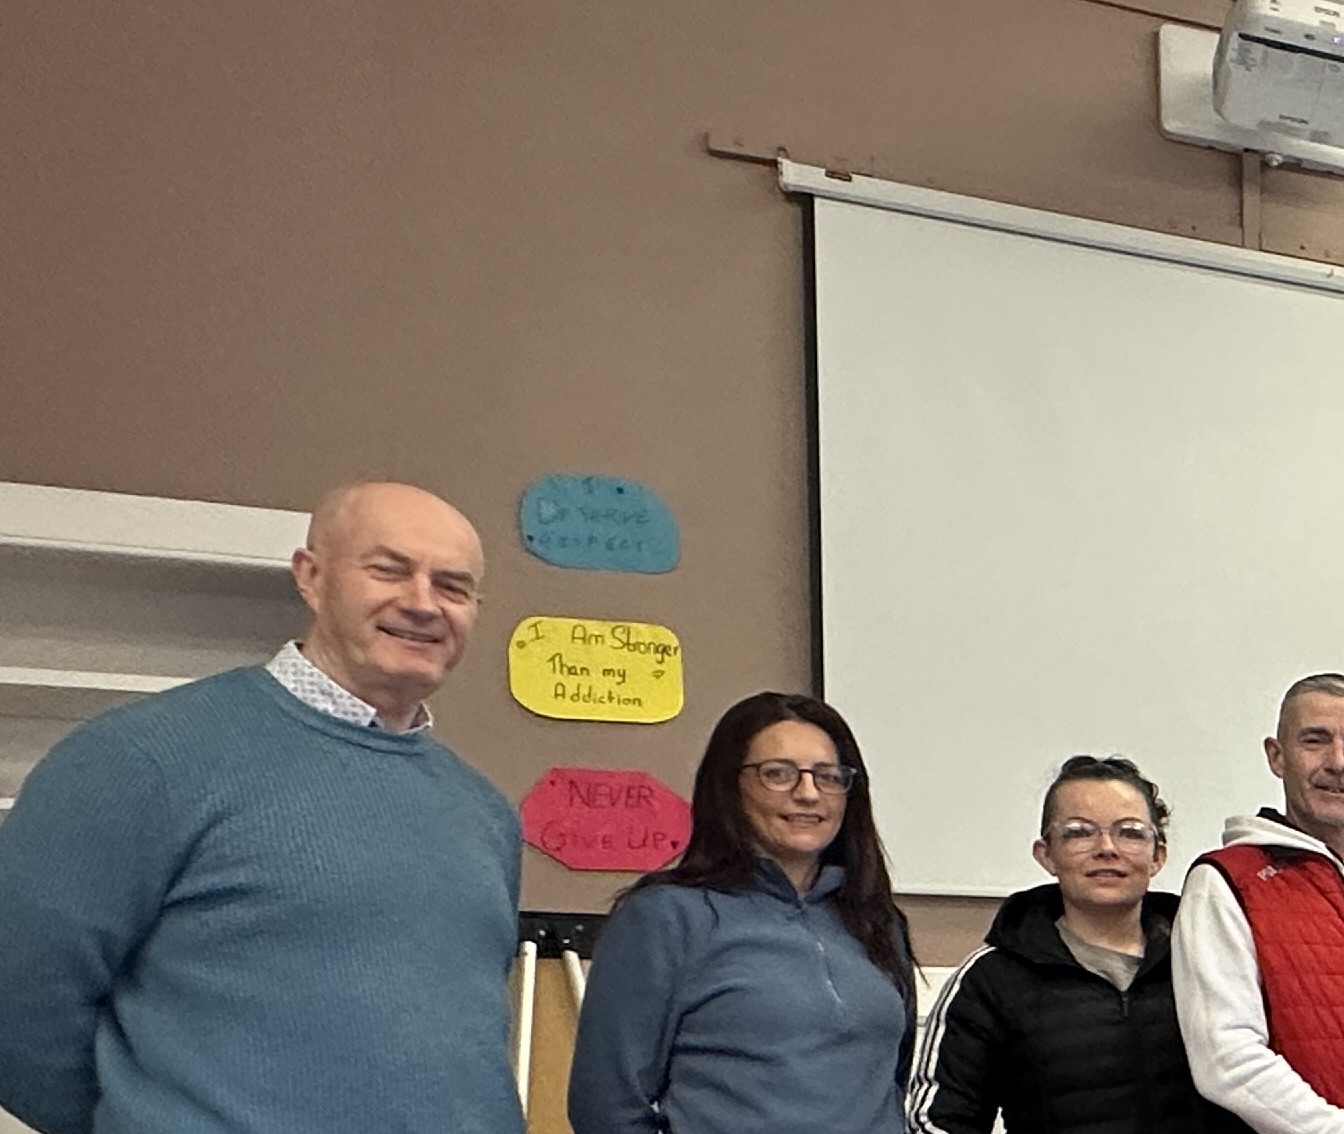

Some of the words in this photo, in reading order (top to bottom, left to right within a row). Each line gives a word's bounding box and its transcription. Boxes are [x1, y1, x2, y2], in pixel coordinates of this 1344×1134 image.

[528, 621, 546, 641] I
[571, 624, 606, 645] Am
[610, 625, 680, 664] Stronger
[547, 653, 590, 677] Than
[602, 667, 627, 686] my
[554, 682, 643, 707] Addiction
[568, 780, 654, 809] NEVER
[627, 827, 667, 850] UP
